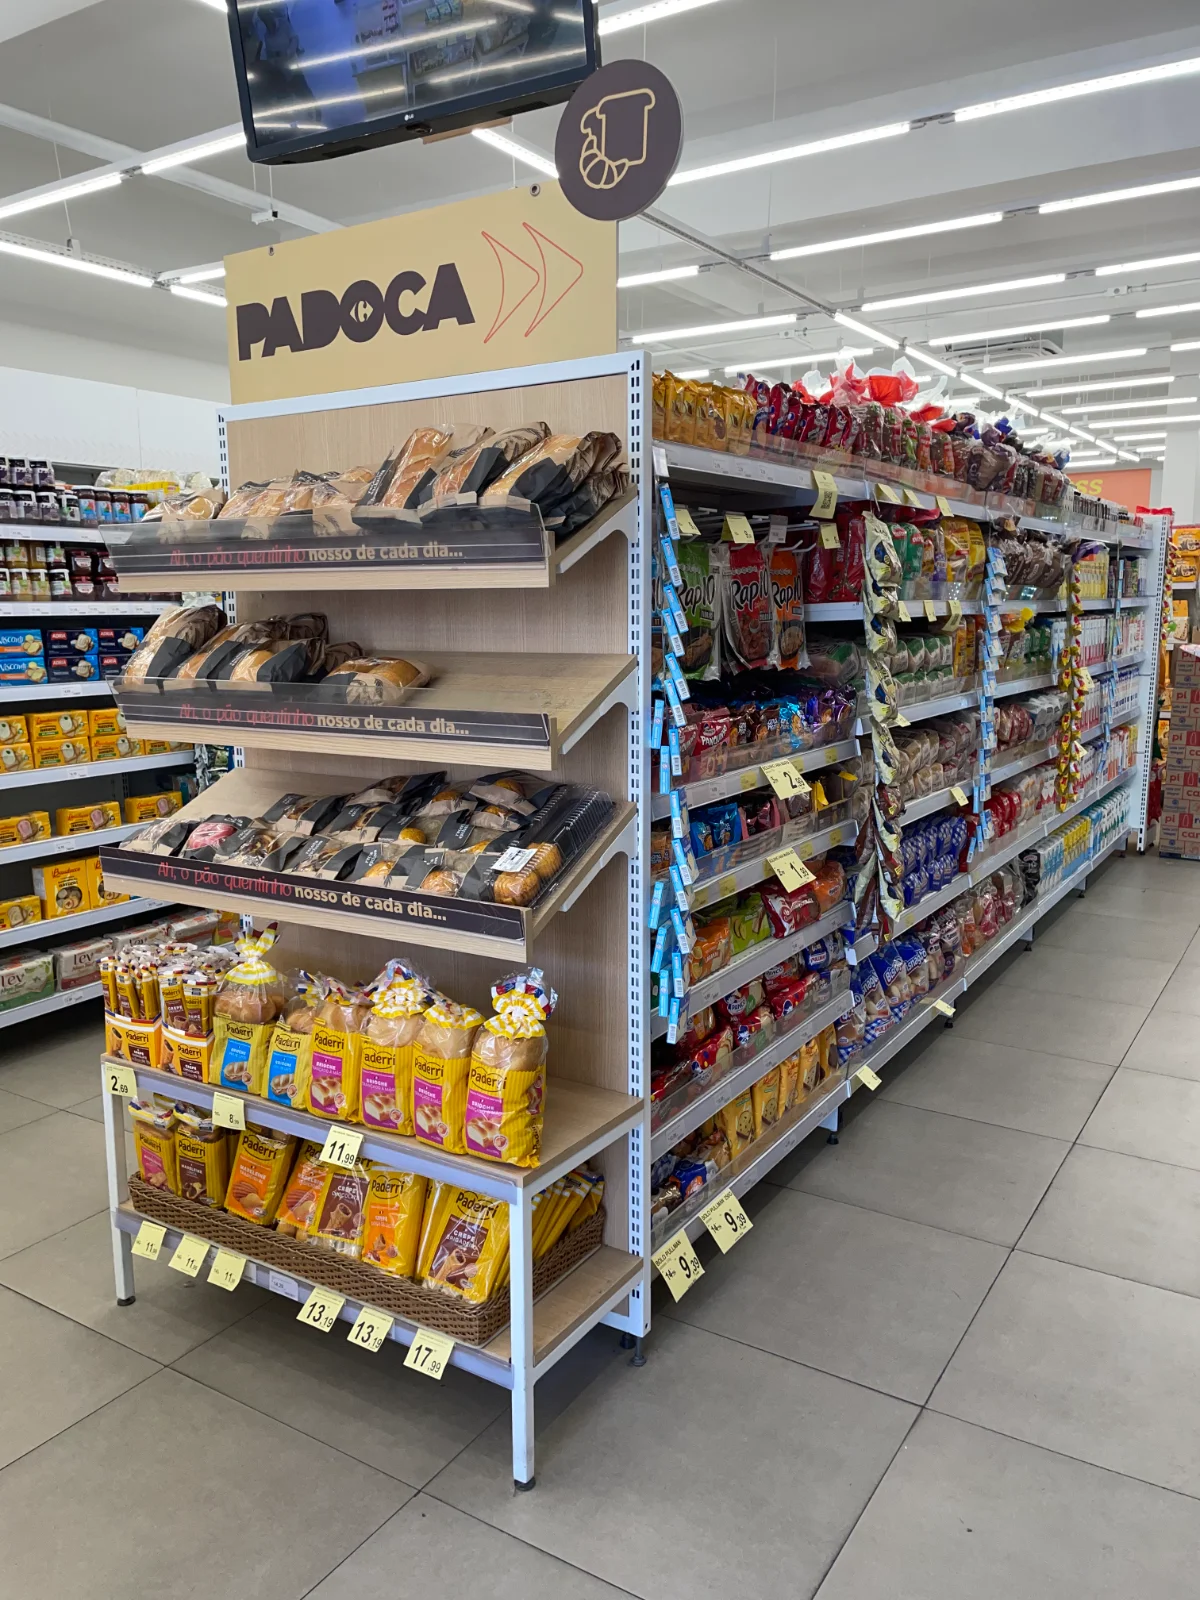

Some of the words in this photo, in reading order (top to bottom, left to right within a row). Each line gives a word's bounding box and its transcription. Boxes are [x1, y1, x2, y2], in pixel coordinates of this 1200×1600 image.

[236, 262, 475, 361] PADOCA
[193, 553, 200, 565] o
[207, 546, 232, 567] pão
[237, 545, 305, 568] quentinho
[308, 548, 351, 562] nosso
[356, 544, 375, 560] de
[380, 542, 418, 559] cada
[423, 541, 463, 558] dia...
[731, 569, 769, 612] Rap10
[1176, 691, 1187, 700] pi
[202, 708, 211, 720] o
[216, 704, 241, 724] pão
[246, 707, 315, 727] quentinho
[317, 714, 360, 730] nosso
[363, 714, 383, 731] de
[387, 716, 426, 733] cada
[430, 718, 469, 736] dia...
[1172, 734, 1182, 742] pi
[1170, 773, 1180, 781] pi
[1165, 815, 1176, 824] pi
[52, 867, 81, 878] Bauducco
[157, 861, 177, 881] Ah,
[181, 868, 190, 881] o
[194, 866, 219, 885] pão
[224, 873, 292, 897] quentinho
[294, 885, 338, 904] nosso
[341, 891, 361, 908] de
[365, 895, 403, 915] cada
[407, 900, 448, 921] dia...
[125, 1031, 149, 1043] Paderri
[226, 1023, 254, 1038] Paderri
[314, 1032, 345, 1050] Paderri
[177, 1044, 202, 1059] Paderri
[363, 1051, 396, 1067] aderri
[415, 1059, 444, 1078] Paderri
[471, 1067, 507, 1090] Paderri
[110, 1074, 129, 1094] 2,69
[139, 1134, 162, 1152] Paderri
[178, 1142, 206, 1157] Paderri
[242, 1135, 277, 1160] Paderri
[328, 1140, 355, 1165] 11,99
[371, 1179, 405, 1195] Paderri
[456, 1191, 499, 1218] Paderri
[724, 1211, 746, 1232] 9,39
[655, 1254, 667, 1267] BOLO
[665, 1240, 681, 1256] PULLMAN
[679, 1256, 700, 1279] 9,39
[306, 1301, 333, 1328] 13,19
[354, 1321, 383, 1349] 13,19
[413, 1344, 441, 1373] 17,99
